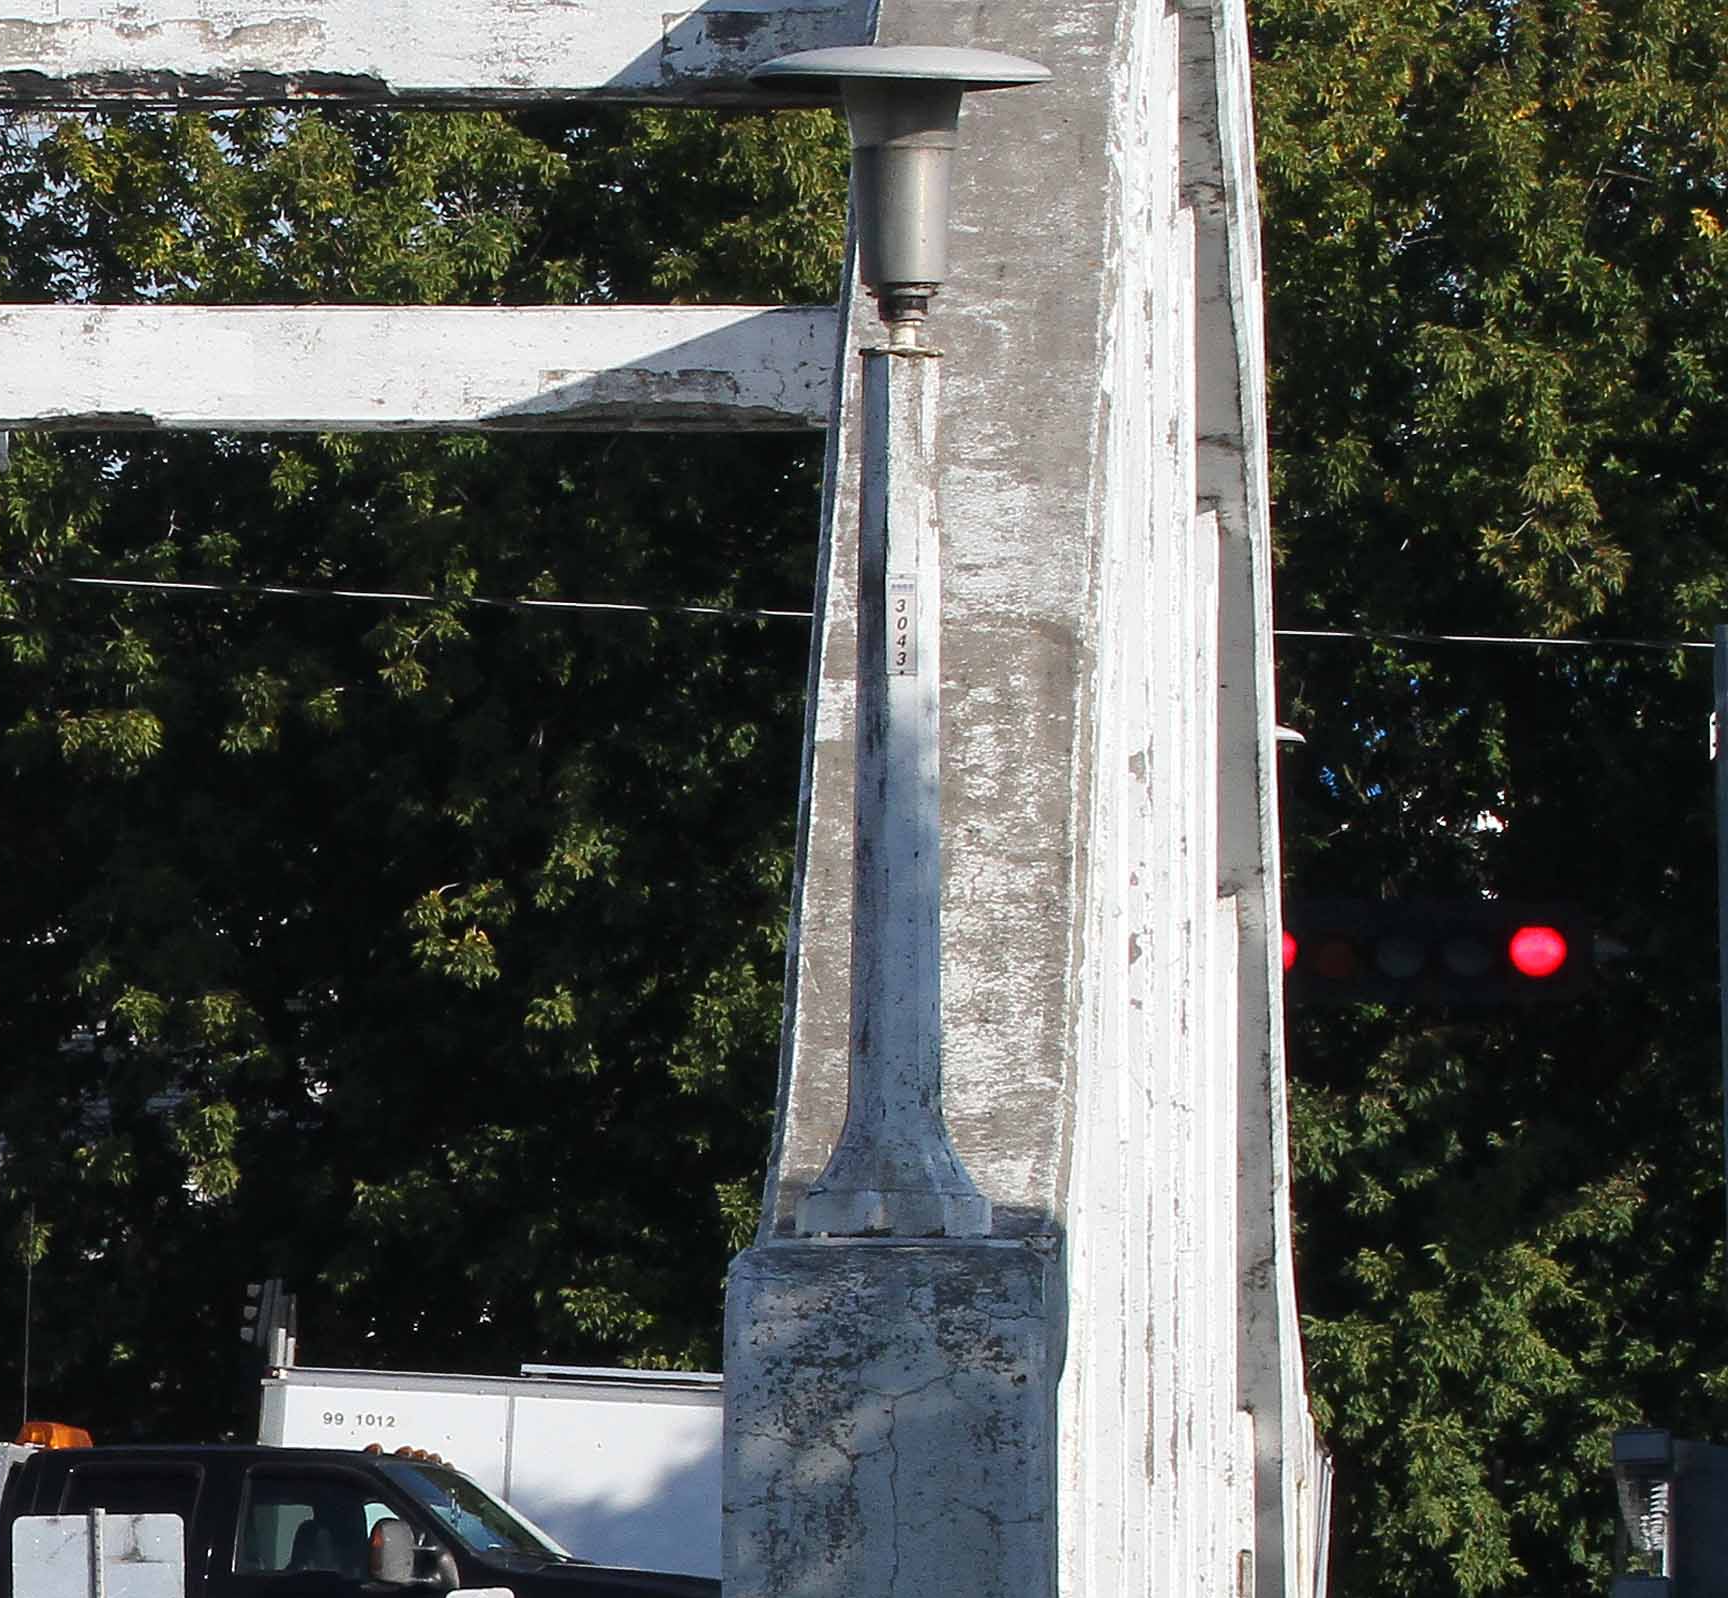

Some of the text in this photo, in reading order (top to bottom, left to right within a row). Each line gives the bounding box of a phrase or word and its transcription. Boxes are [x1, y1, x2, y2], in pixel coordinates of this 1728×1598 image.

[895, 598, 908, 666] 3043
[322, 1412, 396, 1428] 99 1012
